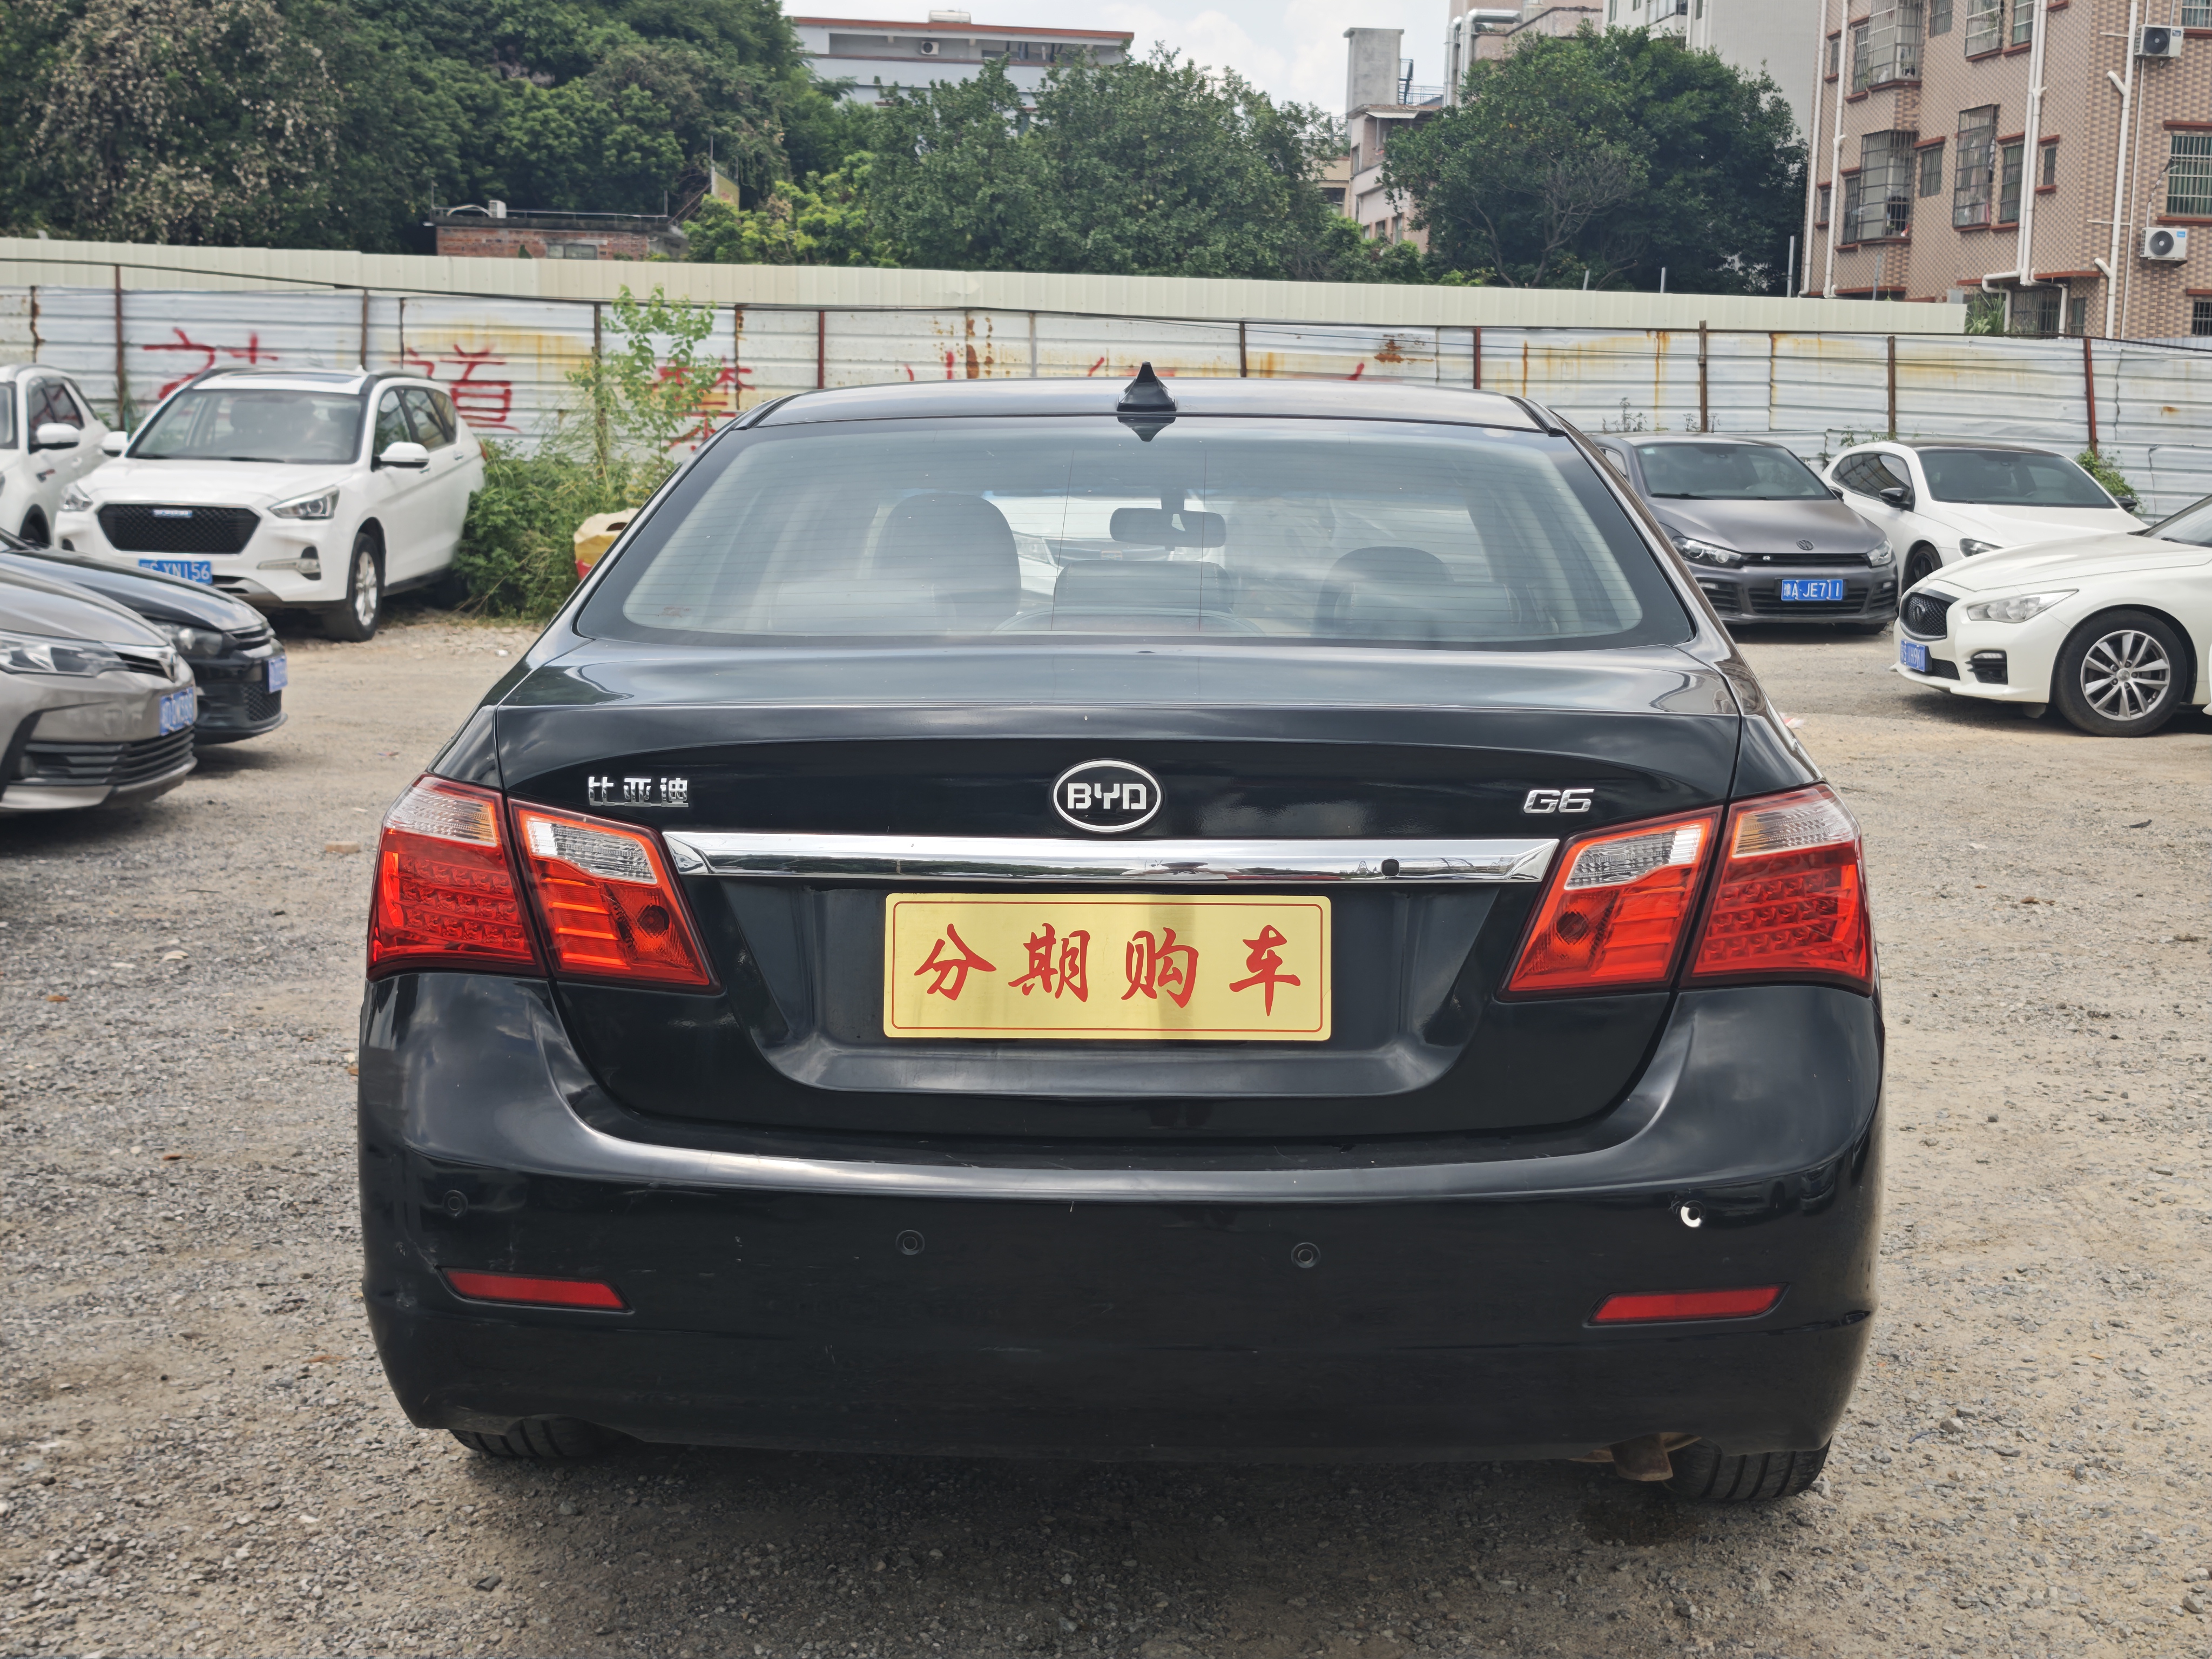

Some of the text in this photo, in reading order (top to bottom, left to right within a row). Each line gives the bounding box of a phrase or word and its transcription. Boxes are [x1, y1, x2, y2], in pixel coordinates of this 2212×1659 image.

[588, 776, 689, 808] 比亚迪
[1067, 783, 1147, 810] BYD
[1523, 788, 1595, 814] G6
[914, 922, 1301, 1017] 分期购车
